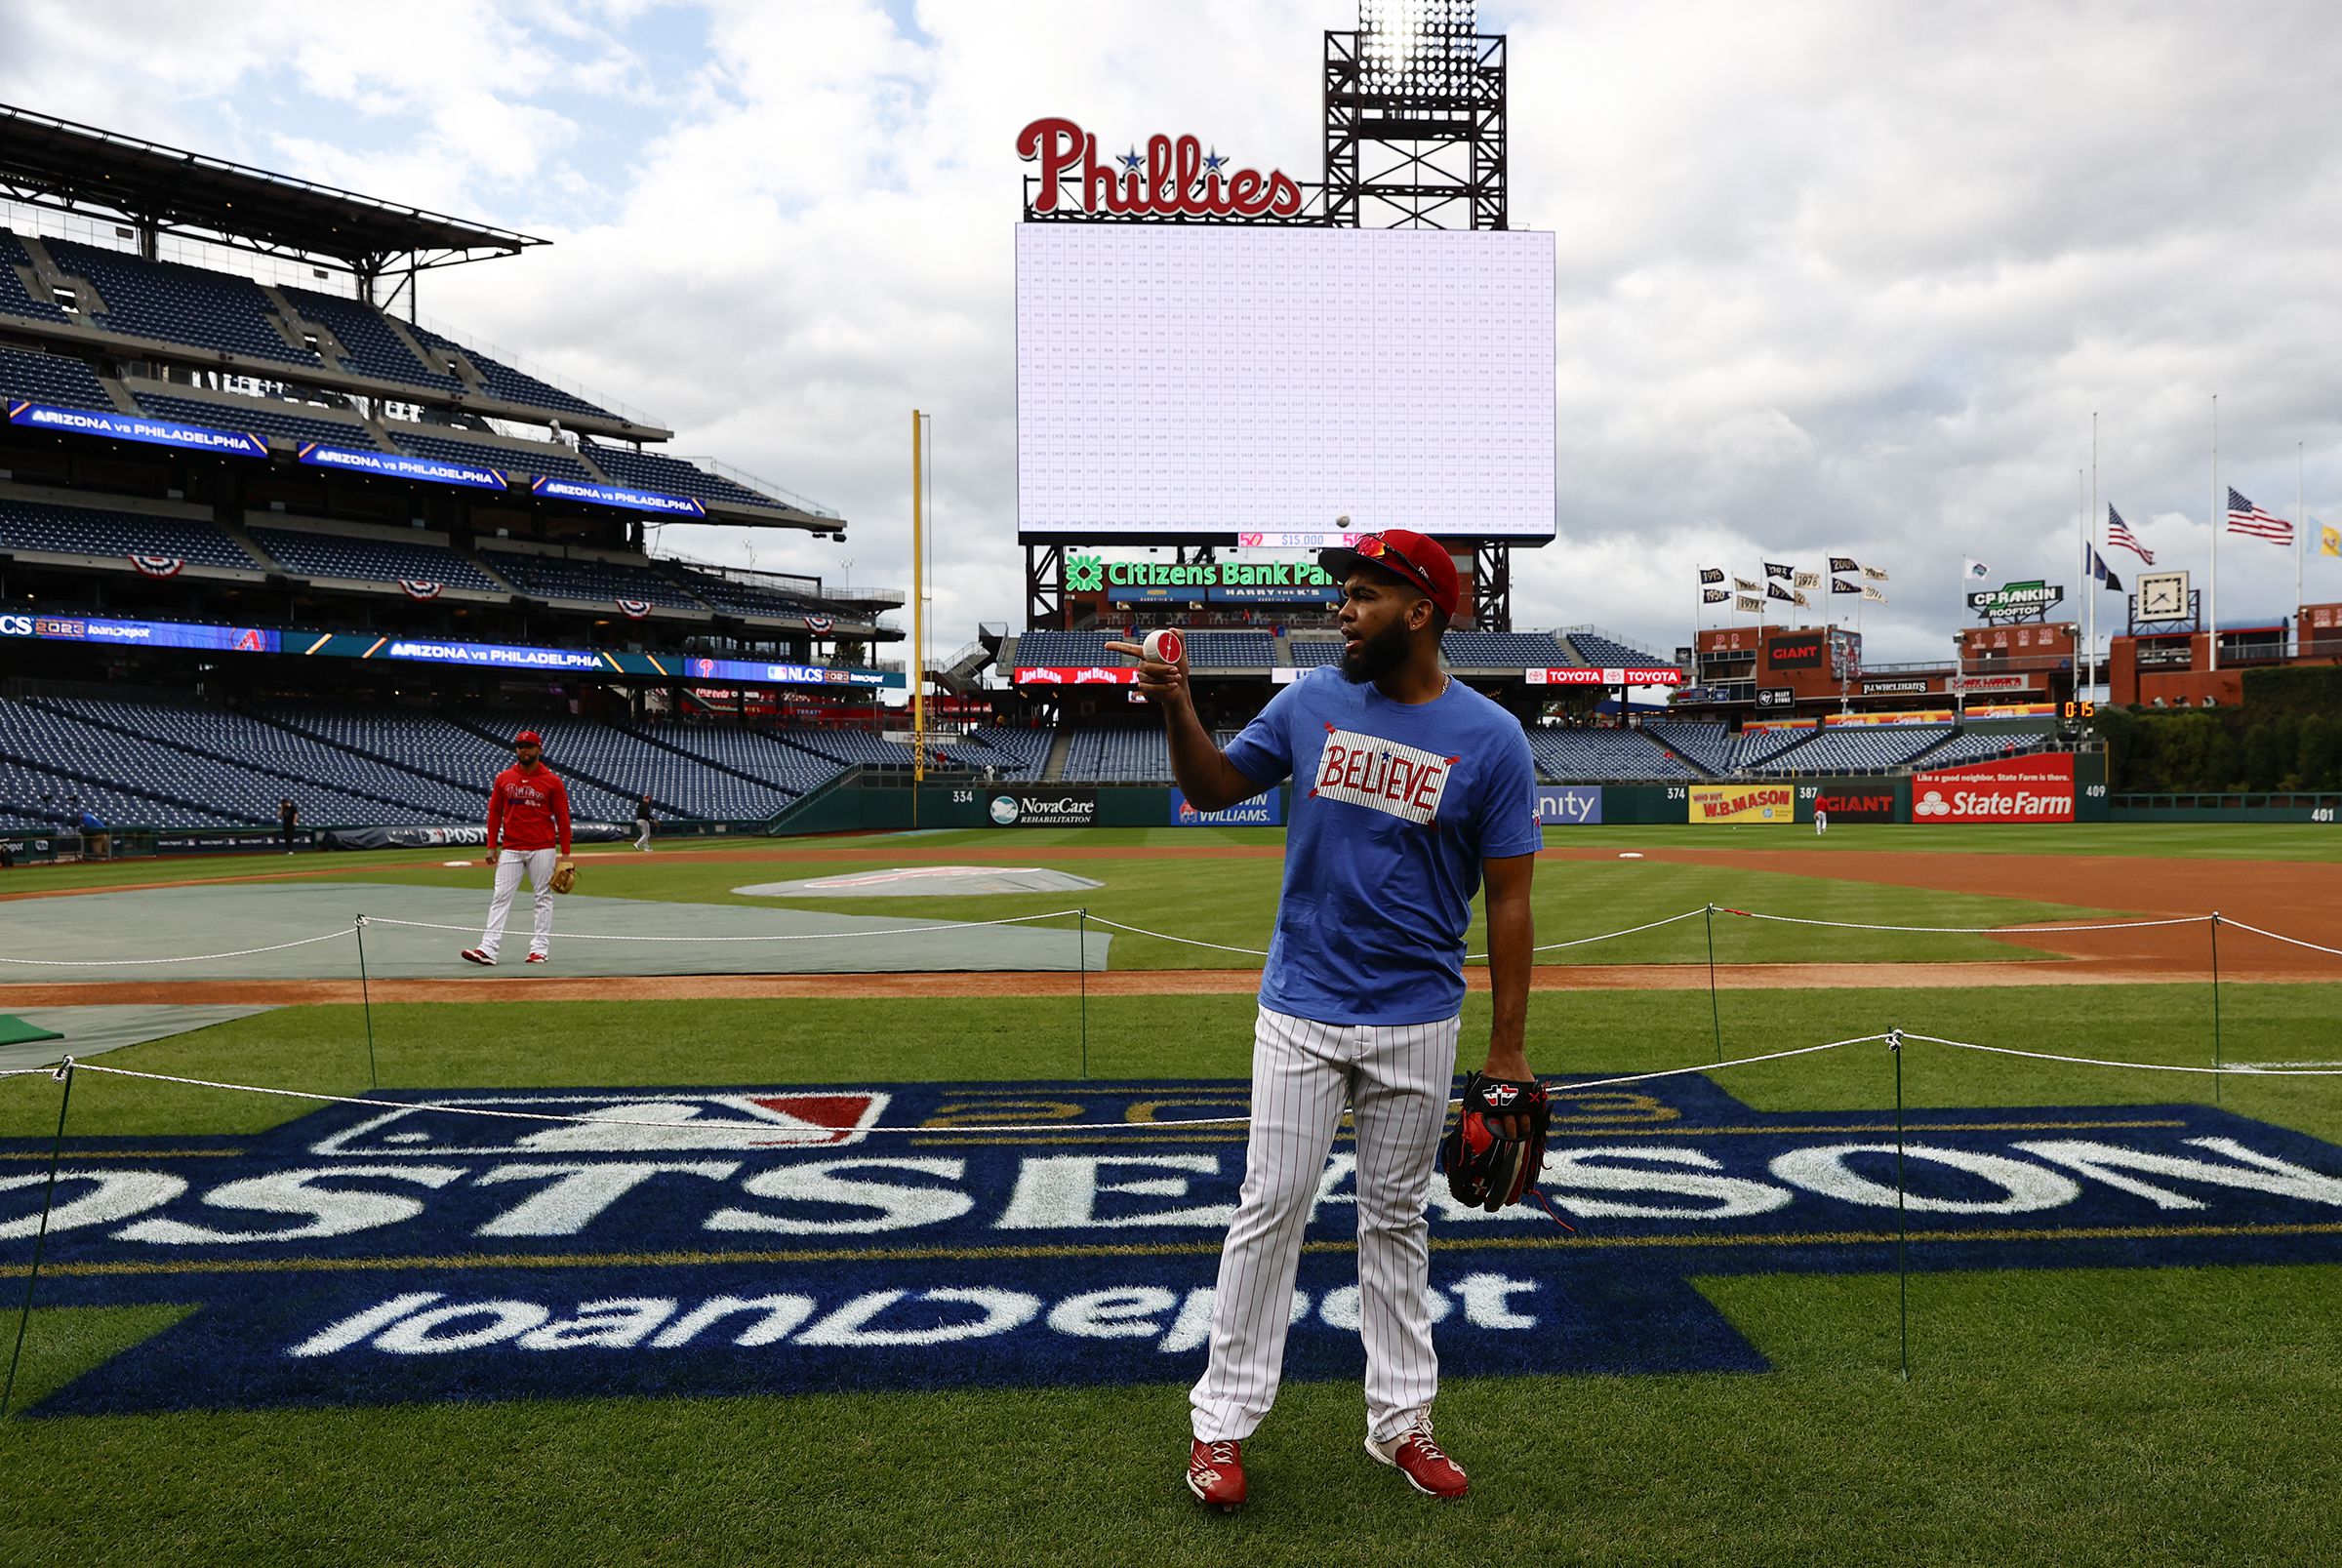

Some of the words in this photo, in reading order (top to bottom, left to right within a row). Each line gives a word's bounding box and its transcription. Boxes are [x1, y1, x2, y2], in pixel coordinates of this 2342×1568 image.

[1016, 116, 1303, 216] Phillies
[32, 410, 111, 431] ARIZONA
[134, 424, 251, 451] PHILADELPHIA
[316, 450, 381, 468] ARIZONA
[399, 462, 494, 484] PHILADELPHIA
[546, 483, 600, 500] ARIZONA
[615, 492, 694, 512] PHILADELPHIA
[1281, 535, 1324, 545] $15,000
[1109, 561, 1217, 585] Citizens
[1222, 560, 1290, 585] Bank
[1293, 561, 1344, 585] Par
[1704, 570, 1722, 582] 1915
[1707, 590, 1725, 600] 1950
[1974, 593, 1997, 605] CP
[1998, 587, 2056, 603] RANKIN
[1989, 606, 2040, 617] ROOFTOP
[35, 621, 85, 635] 2023
[88, 624, 150, 639] loanDepot
[390, 642, 468, 660] ARIZONA
[490, 650, 603, 667] PHILADELPHIA
[1772, 646, 1818, 660] GIANT
[787, 666, 824, 683] NLCS
[825, 672, 849, 681] 2023
[1019, 669, 1035, 684] JIM
[1036, 667, 1062, 684] BEAM
[1073, 669, 1091, 684] JIM
[1092, 667, 1116, 684] BEAM
[1550, 671, 1600, 682] TOYOTA
[1627, 671, 1678, 682] TOYOTA
[2065, 702, 2094, 718] 0:15
[1941, 775, 1959, 784] good
[1961, 775, 1997, 784] neighbor,
[952, 790, 974, 804] 334
[1667, 787, 1685, 800] 374
[1799, 786, 1818, 799] 387
[2086, 785, 2106, 797] 409
[1019, 797, 1094, 814] NovaCare
[1826, 796, 1893, 812] GIANT
[2311, 808, 2334, 822] 401
[921, 1092, 1681, 1127] 203
